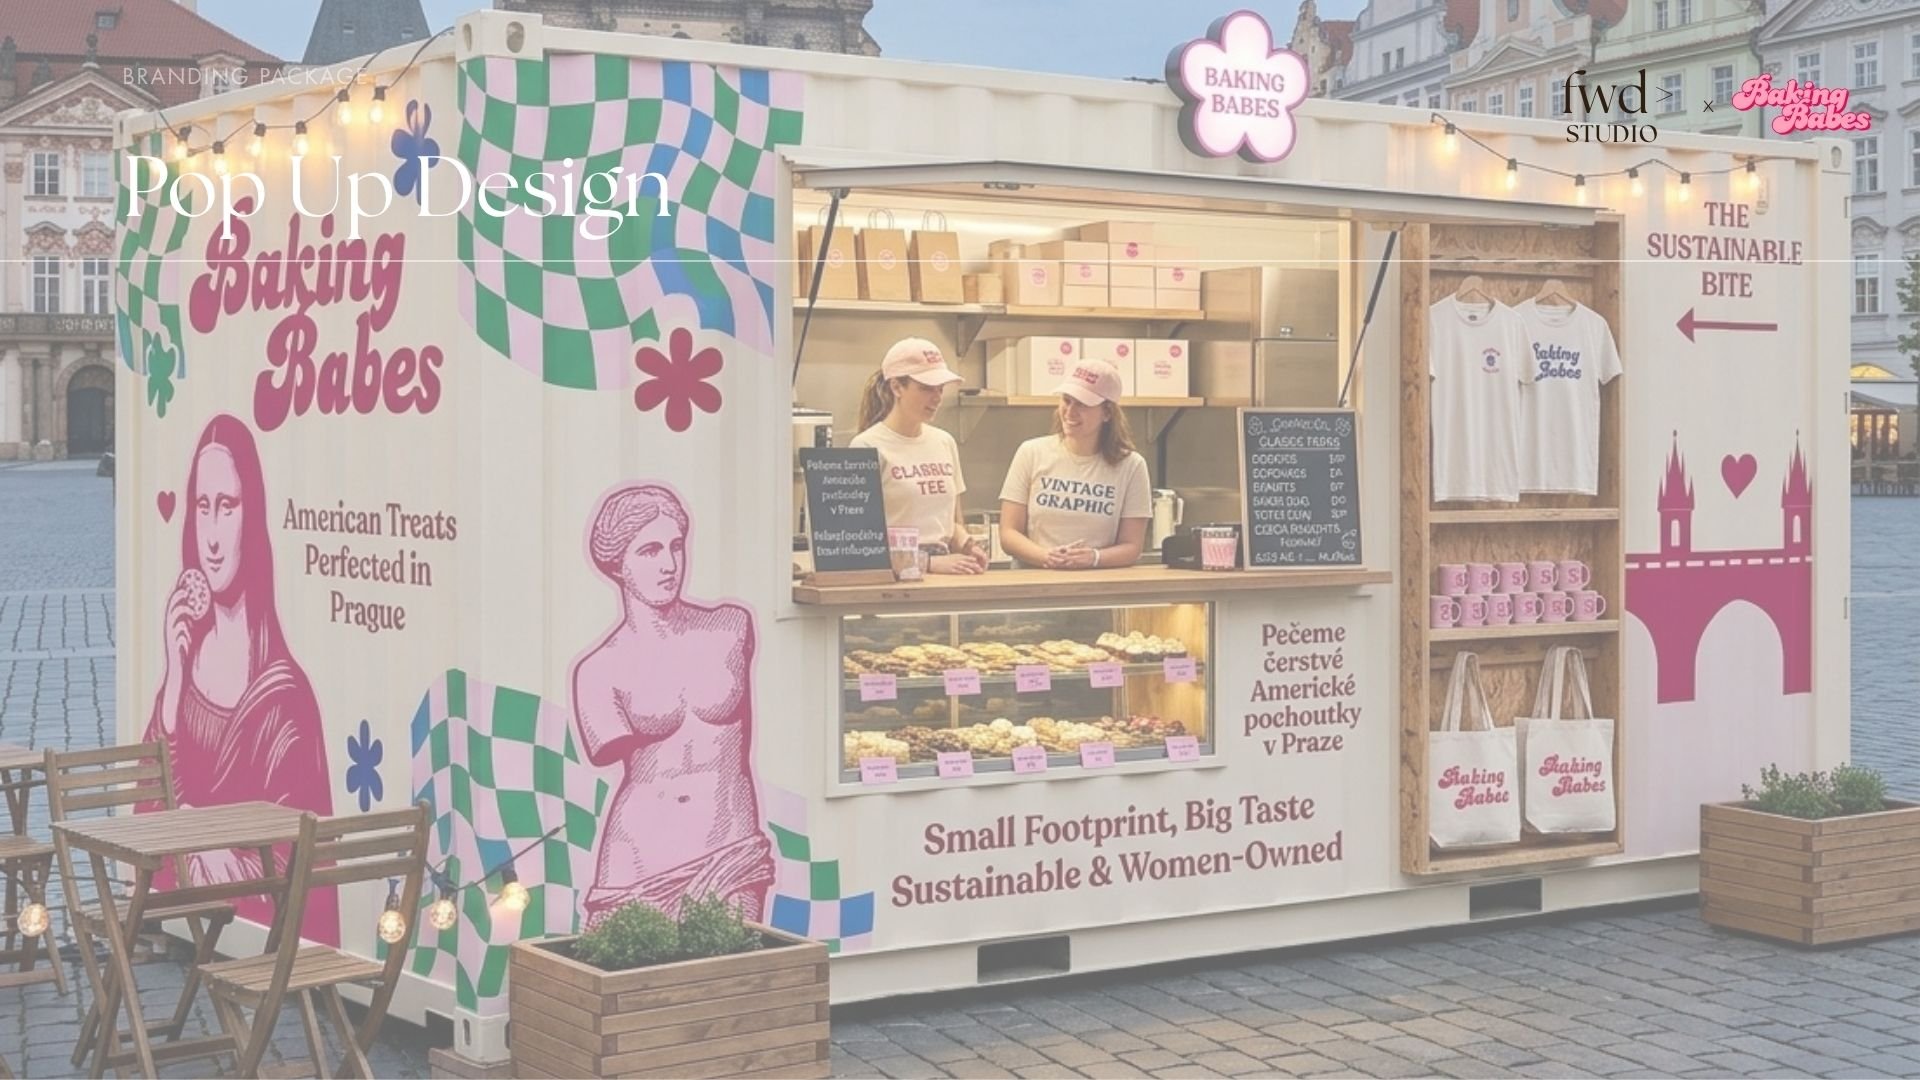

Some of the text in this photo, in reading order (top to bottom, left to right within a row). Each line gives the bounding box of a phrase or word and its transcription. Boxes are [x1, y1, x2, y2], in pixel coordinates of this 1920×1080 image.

[1205, 67, 1285, 93] BAKING
[1211, 94, 1280, 119] BABES
[1704, 201, 1750, 228] THE
[1647, 232, 1803, 266] SUSTAINABLE
[189, 196, 405, 334] Baking
[1701, 271, 1753, 298] BITE
[253, 311, 444, 432] Babes
[917, 480, 947, 496] TEE
[1040, 476, 1116, 500] VINTAGE
[1035, 493, 1116, 516] GRAPHIC
[283, 497, 457, 542] American Treats
[305, 544, 432, 586] Perfected in
[330, 591, 406, 634] Prague
[1261, 621, 1346, 647] Pečeme
[1263, 646, 1344, 673] čerstvé
[1250, 673, 1356, 703] Americké
[1244, 703, 1362, 737] pochoutky
[1263, 733, 1343, 756] v Praze
[924, 794, 1315, 856] Small Footprint, Big Taste
[892, 830, 1343, 908] Sustainable & Women-Owned
